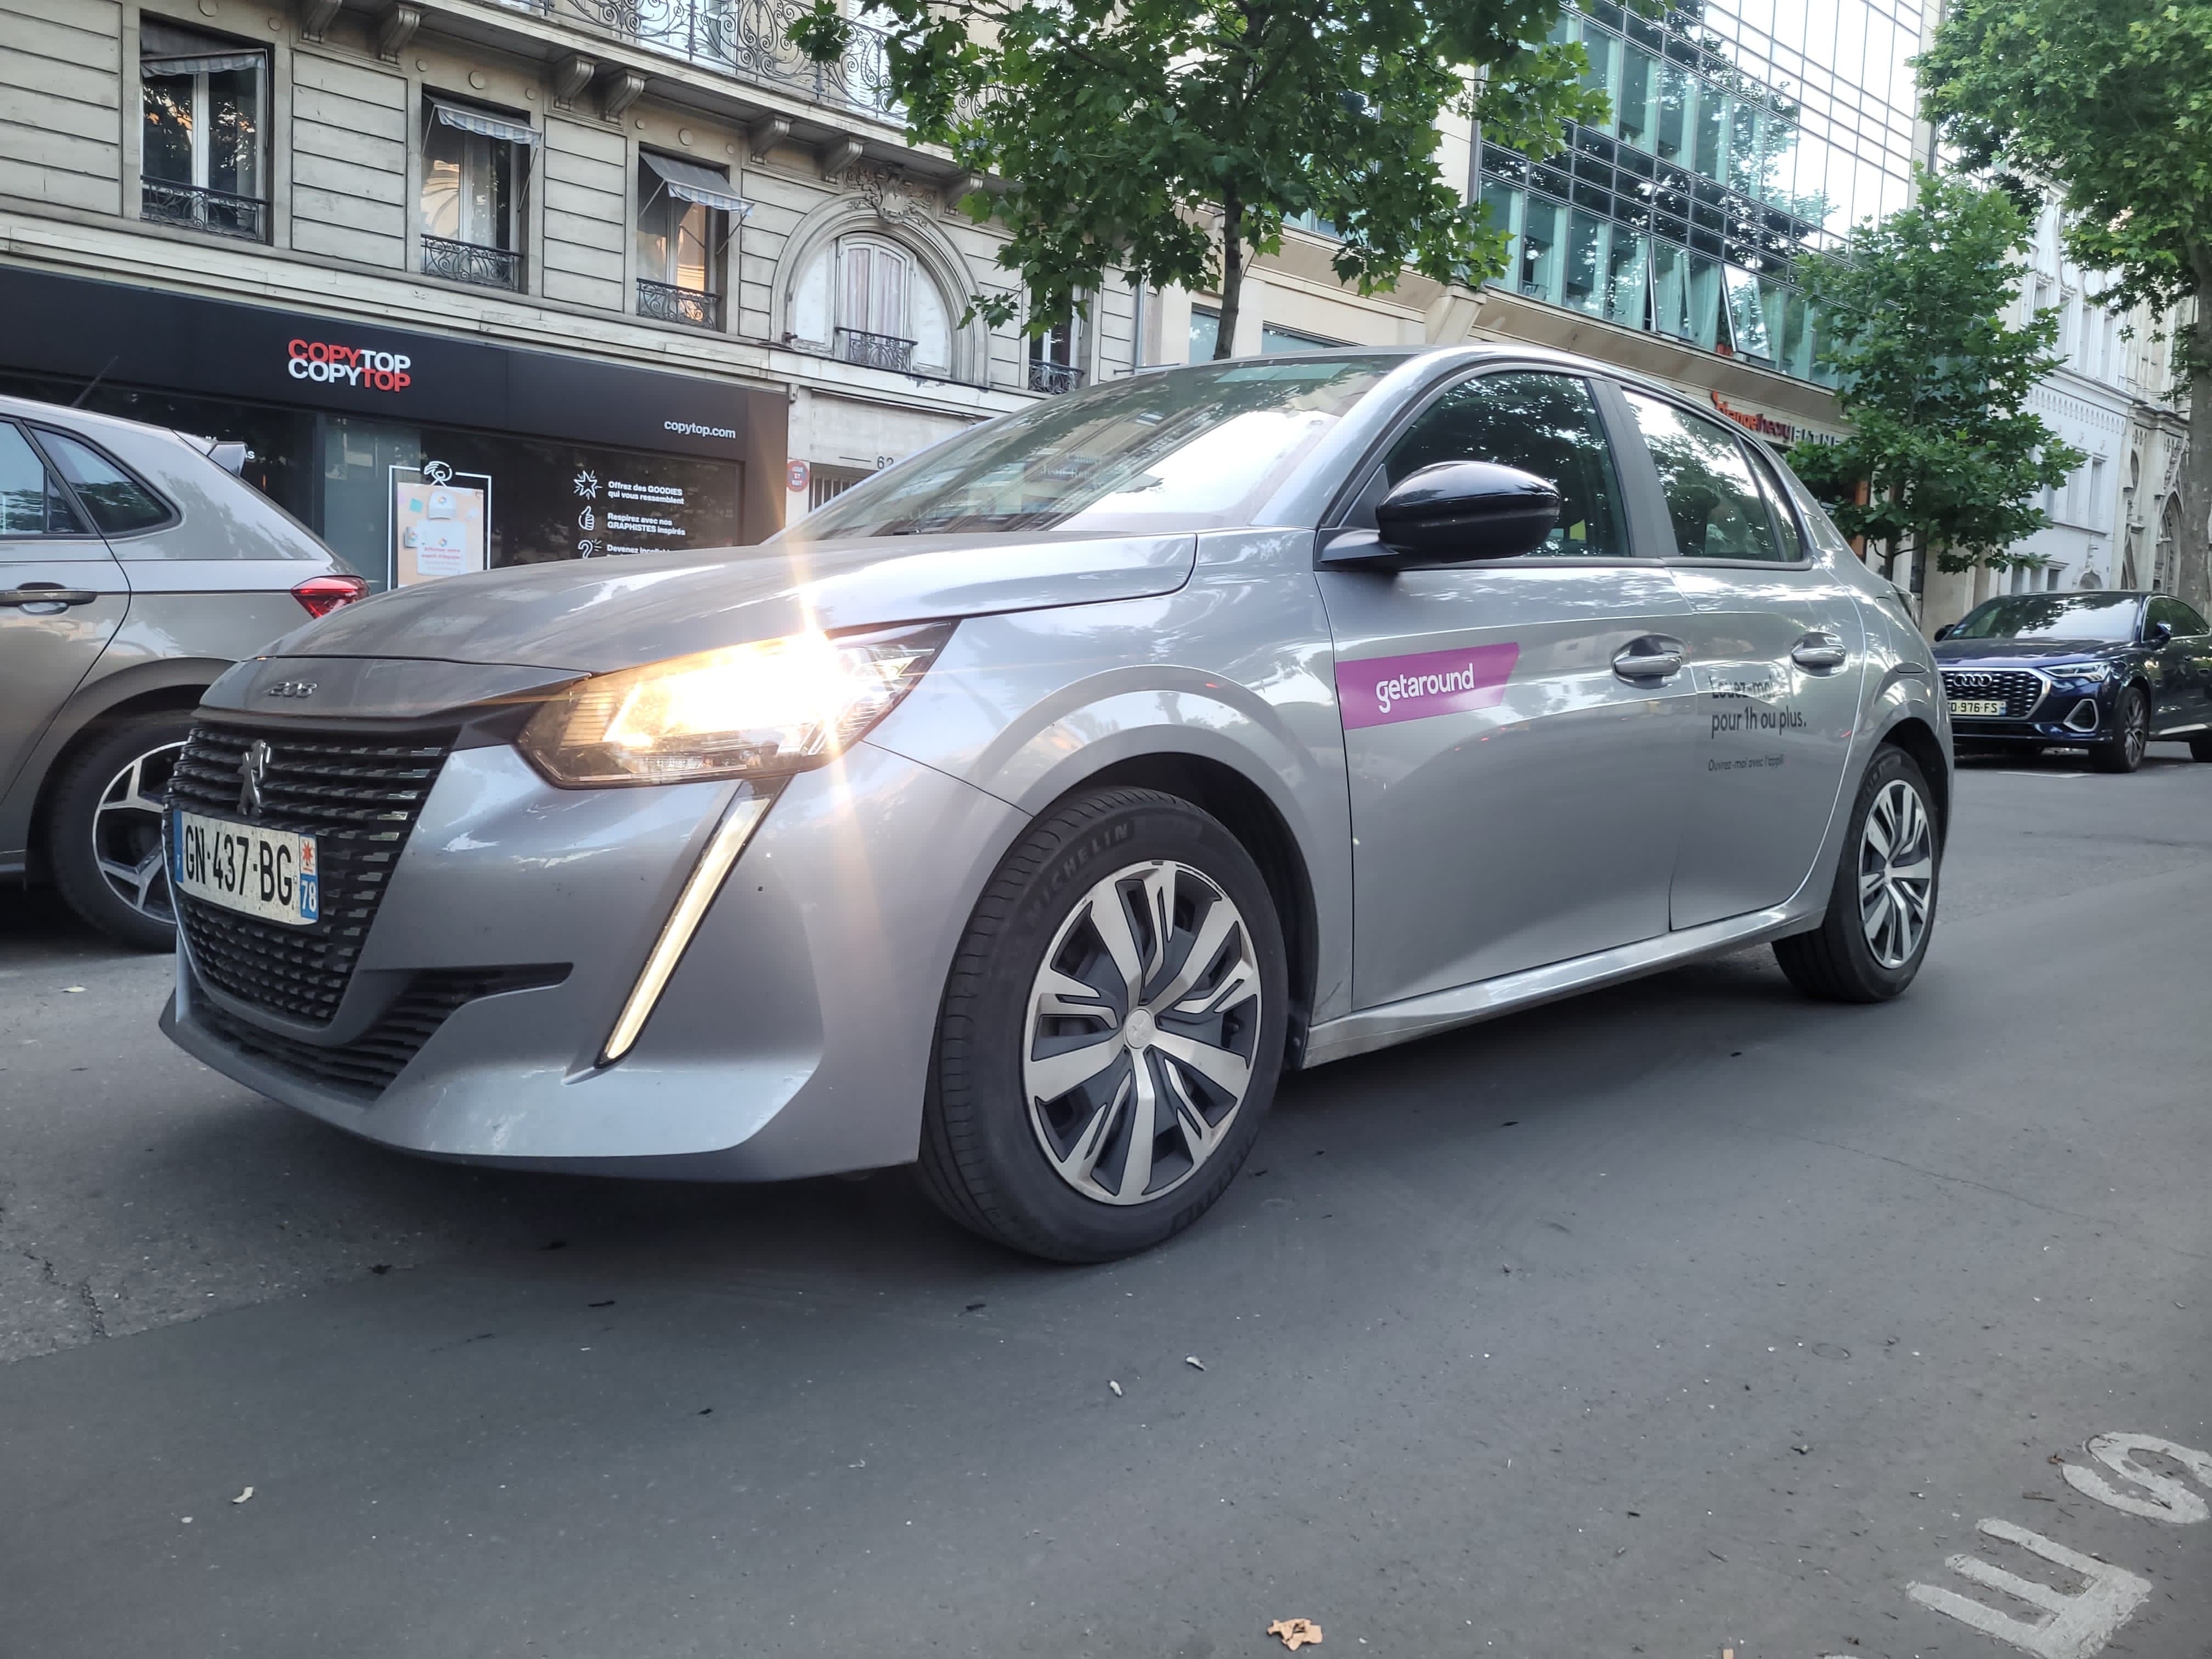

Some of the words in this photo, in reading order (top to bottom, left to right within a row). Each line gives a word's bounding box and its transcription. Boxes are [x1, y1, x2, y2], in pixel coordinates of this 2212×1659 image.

[289, 339, 411, 374] COPYTOP
[288, 358, 411, 392] COPYTOP
[664, 421, 736, 439] copytop.com
[608, 481, 633, 490] Offrez
[648, 486, 683, 496] GOODIES
[640, 494, 685, 504] ressemblent
[607, 512, 640, 523] Respirez
[607, 521, 657, 533] GRAPHISTES
[607, 544, 639, 554] Devenez
[1376, 663, 1475, 714] getaround
[1948, 702, 1997, 713] D-976-FS
[1712, 713, 1742, 740] pour
[1745, 706, 1758, 730] 1h
[1760, 712, 1776, 729] ou
[1779, 704, 1807, 736] plus.
[301, 880, 317, 912] 78
